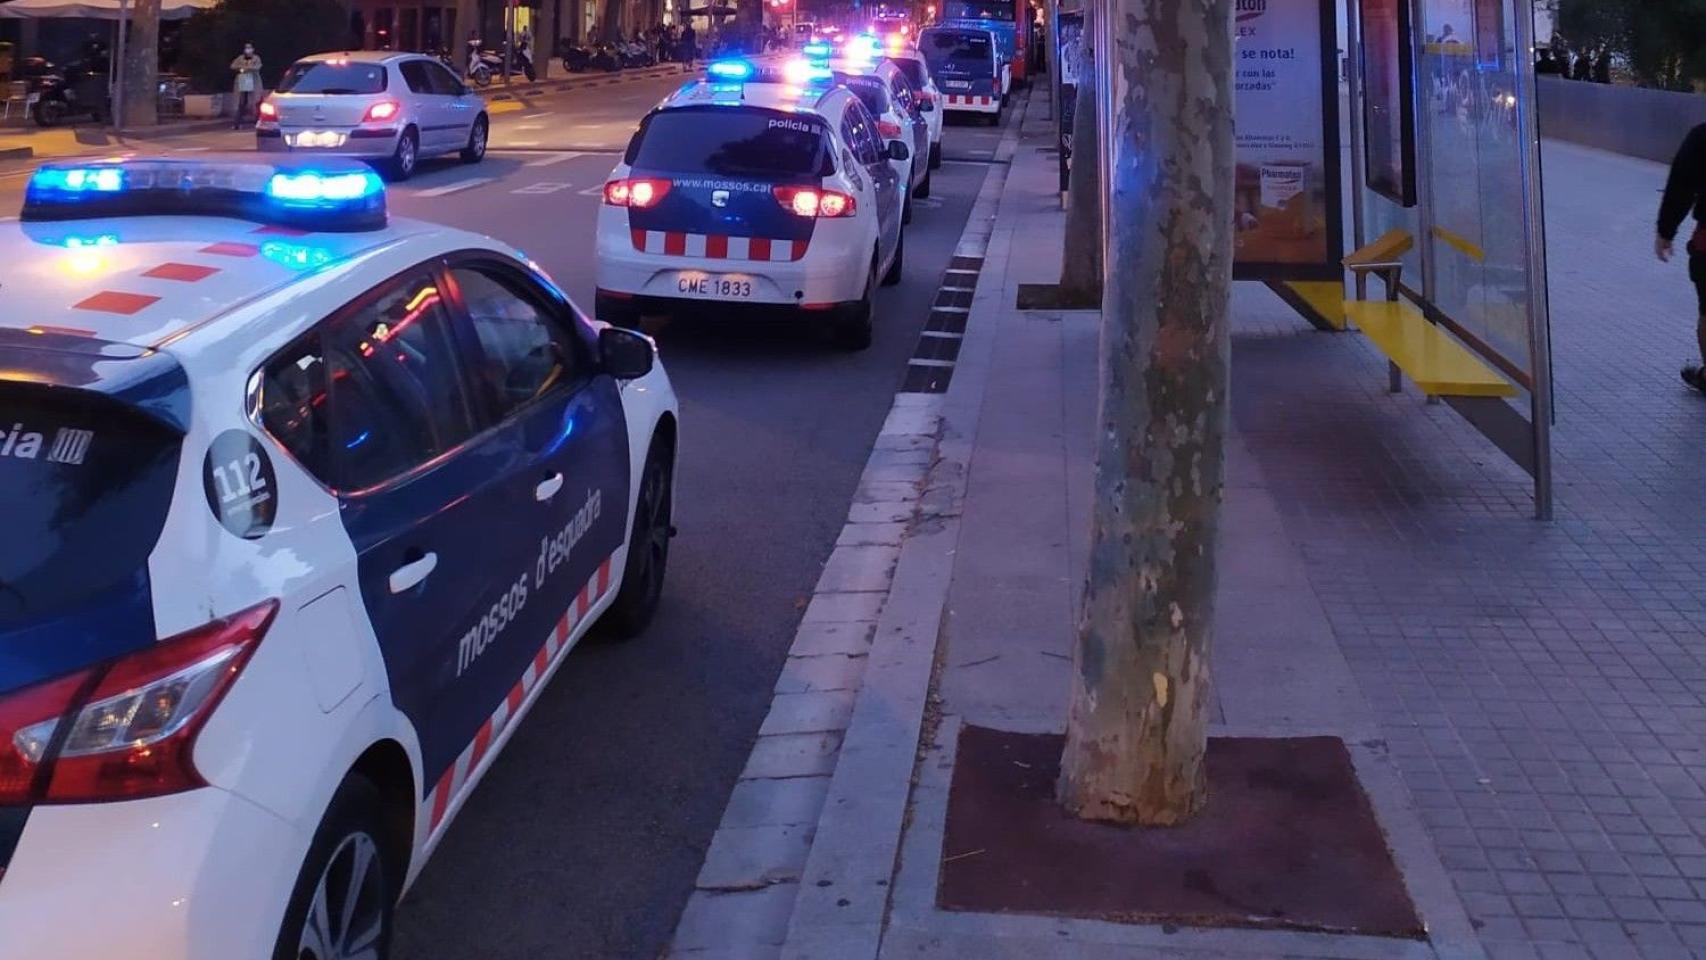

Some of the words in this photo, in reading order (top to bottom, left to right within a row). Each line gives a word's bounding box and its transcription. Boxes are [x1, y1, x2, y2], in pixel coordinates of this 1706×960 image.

[1241, 49, 1257, 59] se
[1260, 48, 1295, 59] nota!
[672, 178, 771, 195] www.mossos.cat
[678, 276, 708, 294] CME
[714, 278, 751, 297] 1833
[0, 423, 43, 460] ia
[213, 452, 266, 502] 112
[456, 572, 529, 677] mossos
[535, 487, 601, 590] d'esquadra
